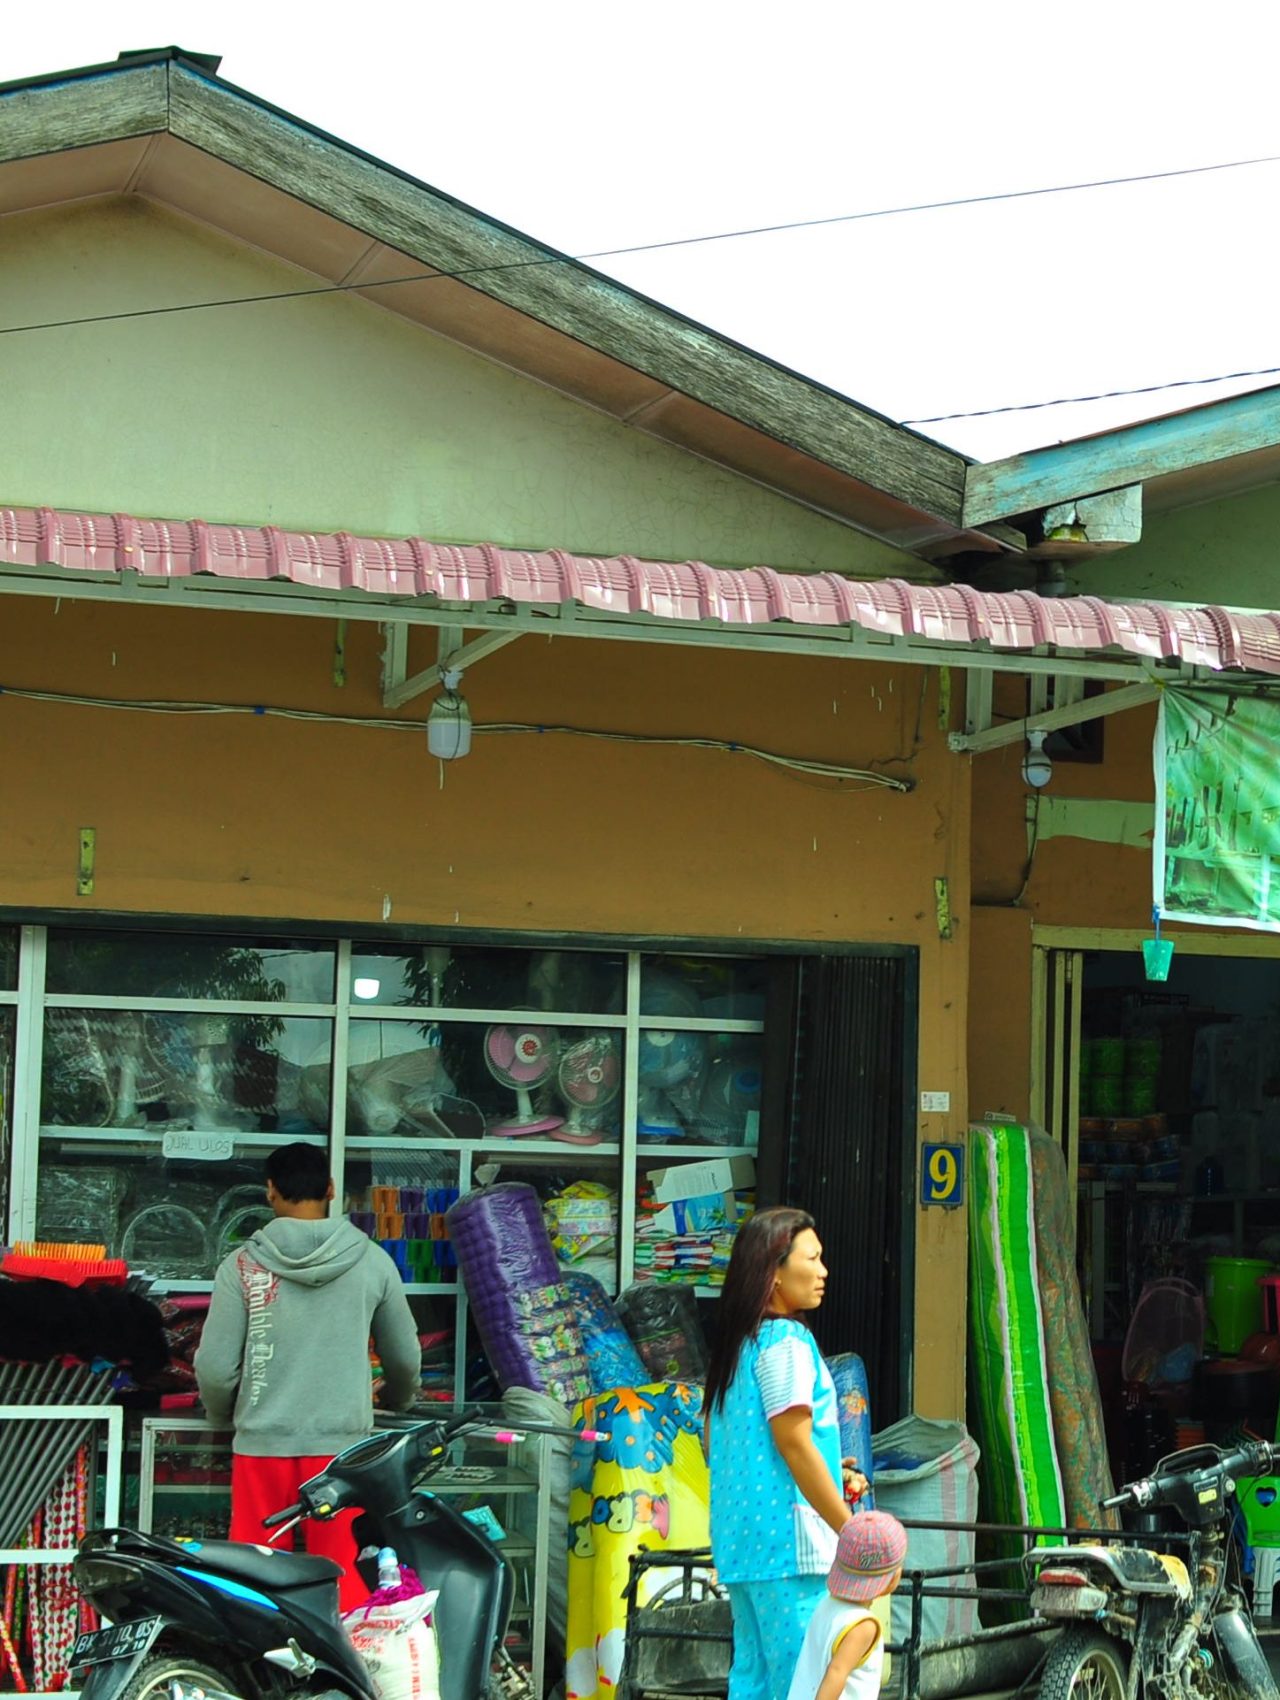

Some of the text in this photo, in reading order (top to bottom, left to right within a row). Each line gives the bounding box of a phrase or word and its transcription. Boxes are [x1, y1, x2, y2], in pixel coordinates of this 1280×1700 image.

[929, 1149, 957, 1199] 9
[248, 1271, 273, 1340] Double
[76, 1632, 98, 1654] BK
[111, 1643, 129, 1655] 07
